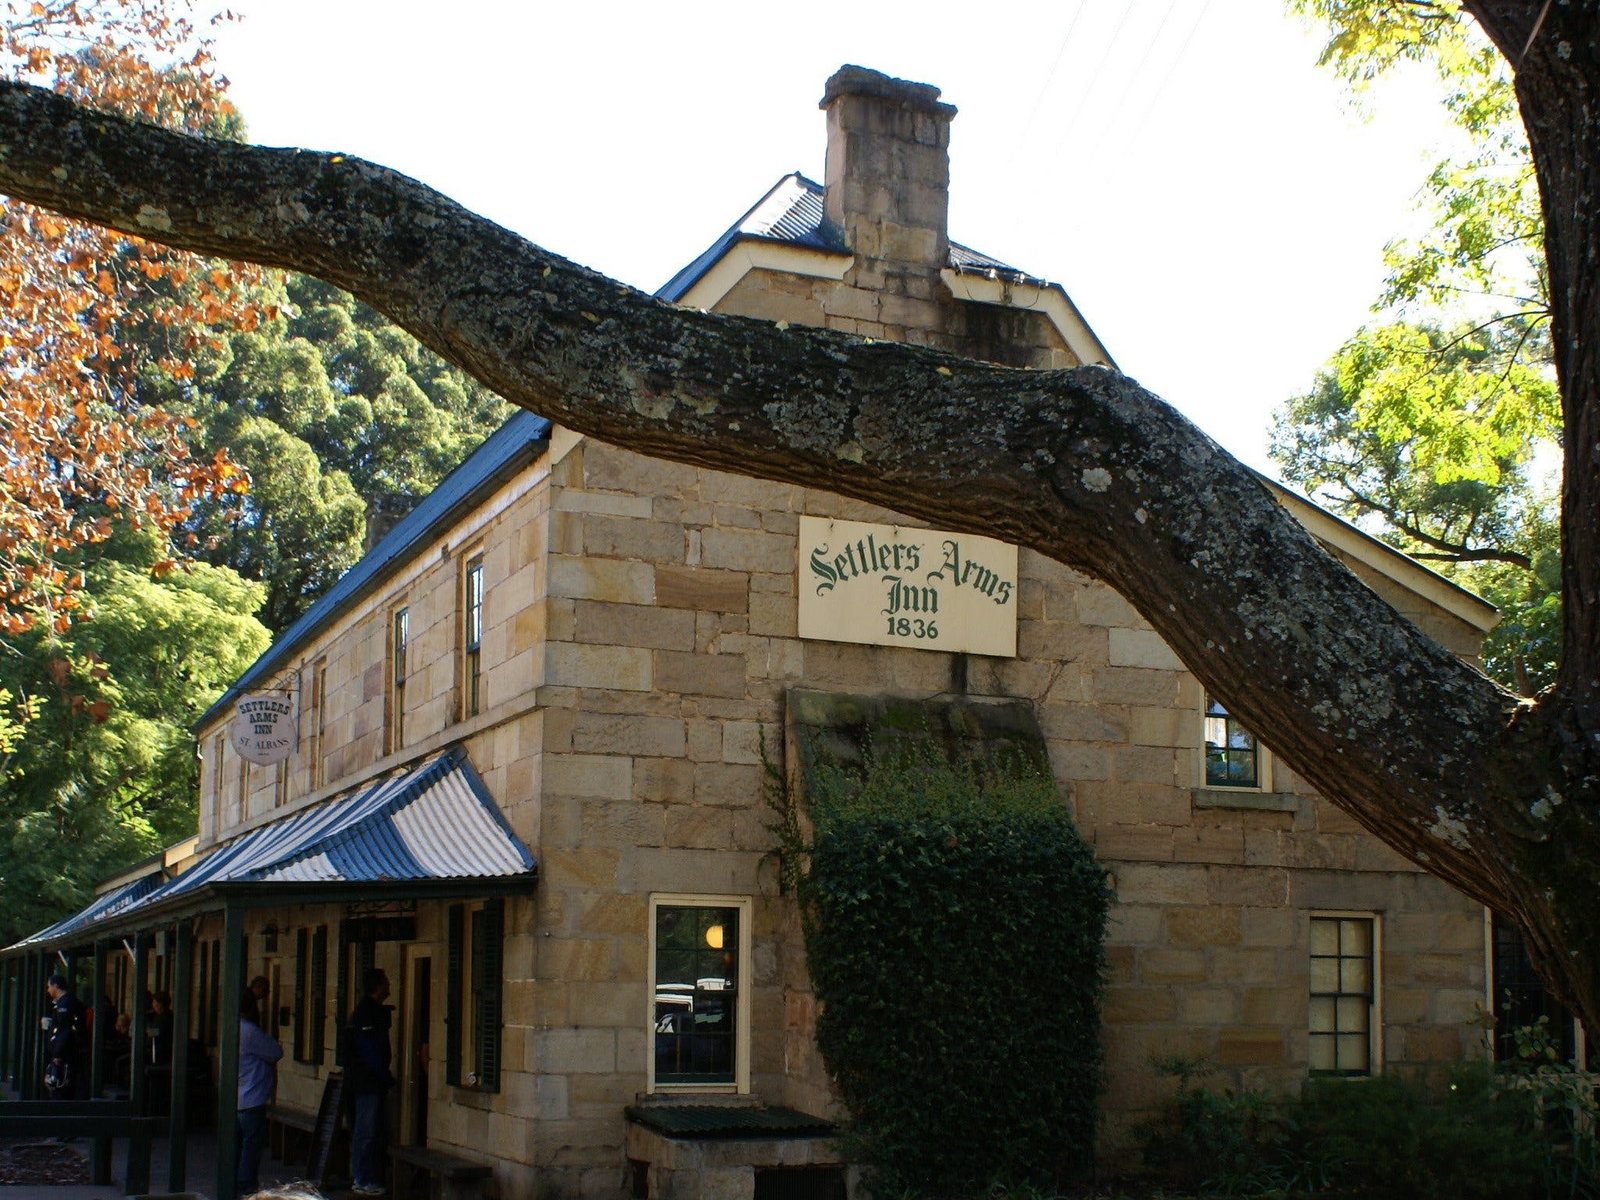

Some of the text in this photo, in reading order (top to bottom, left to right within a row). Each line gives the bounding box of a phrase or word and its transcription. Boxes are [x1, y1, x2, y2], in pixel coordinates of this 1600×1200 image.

[810, 533, 1015, 605] Settlers Arms
[881, 574, 939, 614] Inn
[887, 616, 939, 639] 1836
[239, 701, 290, 715] SETTLERS
[249, 713, 278, 723] ARMS
[254, 724, 273, 734] INN
